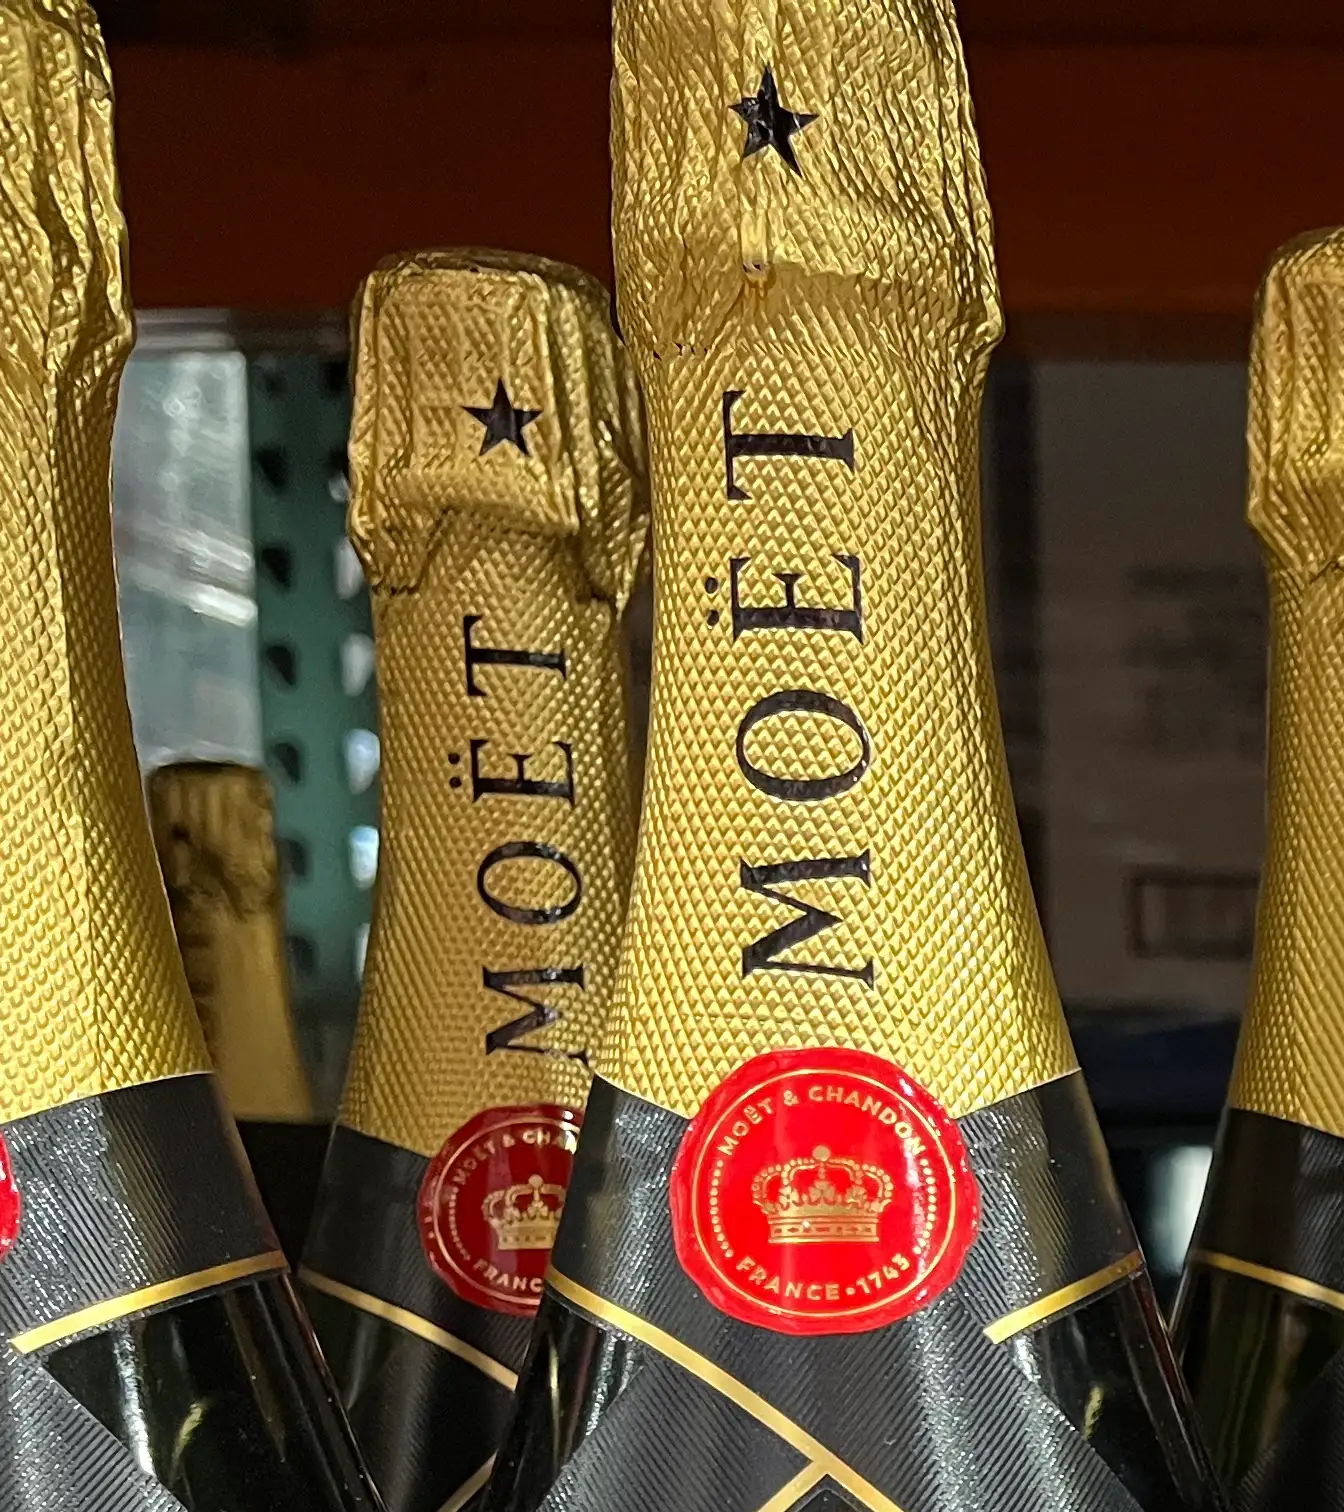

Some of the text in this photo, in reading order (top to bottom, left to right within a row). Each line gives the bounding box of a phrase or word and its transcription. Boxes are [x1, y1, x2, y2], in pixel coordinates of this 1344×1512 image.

[704, 388, 875, 991] MOËT
[447, 613, 588, 1063] MOËT
[783, 1089, 800, 1107] &
[808, 1085, 926, 1157] CHANDON
[735, 1255, 840, 1301] FRANCE
